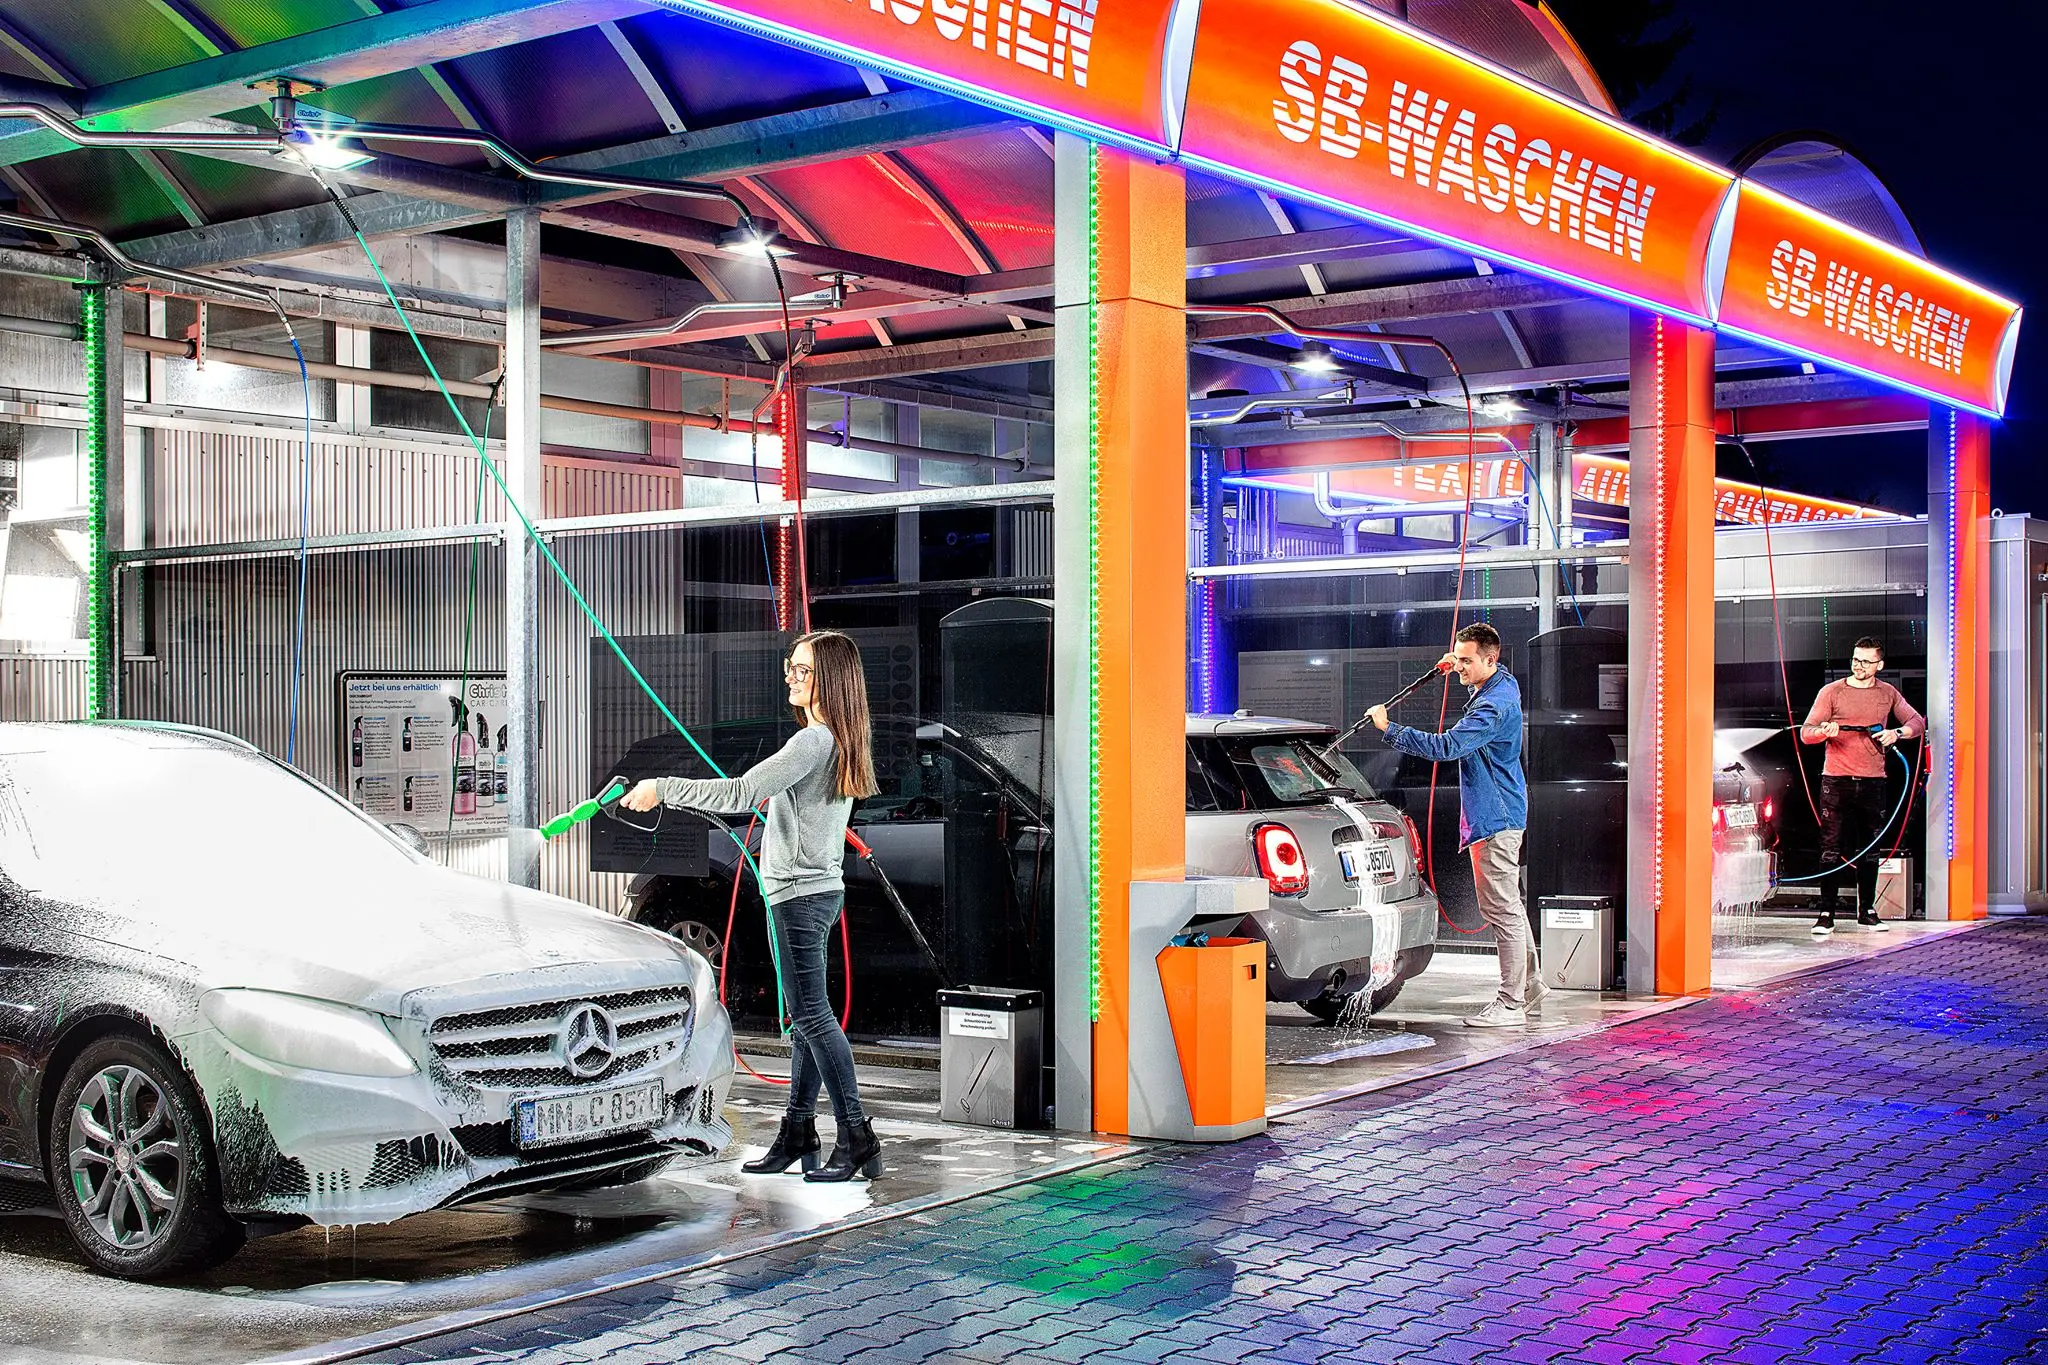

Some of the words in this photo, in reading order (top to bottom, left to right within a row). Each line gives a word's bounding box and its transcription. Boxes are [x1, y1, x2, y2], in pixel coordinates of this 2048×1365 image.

[1272, 40, 1656, 264] SB-WASCHEN
[1766, 239, 1970, 375] SB-WASCHEN
[469, 684, 507, 698] Christ
[1370, 850, 1391, 871] 8570
[590, 1096, 604, 1127] C
